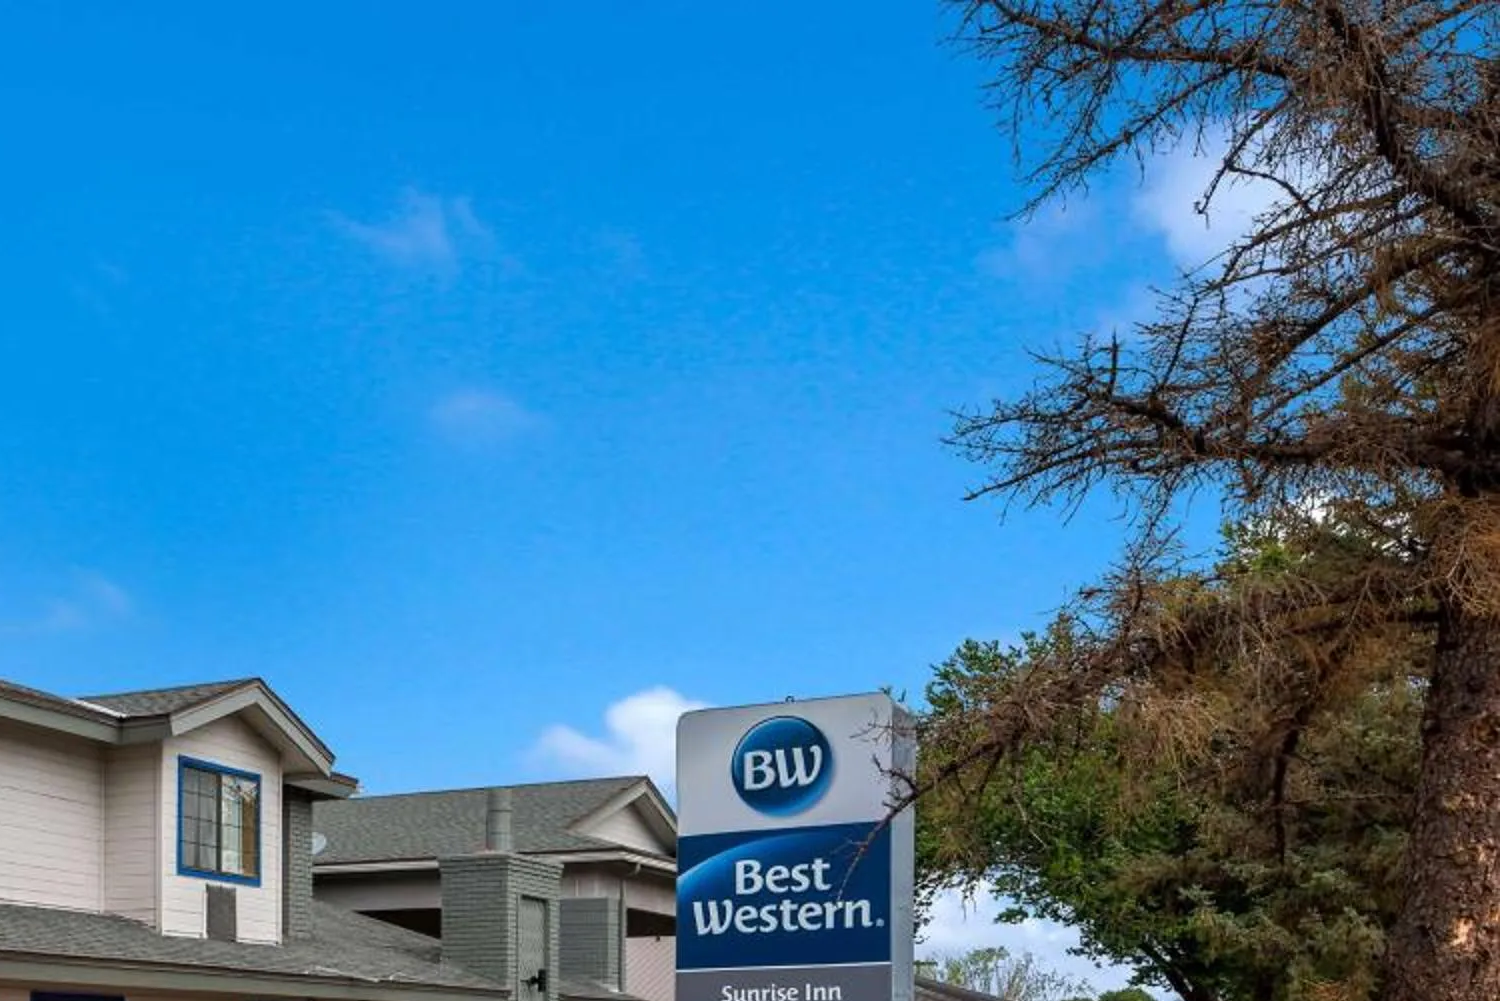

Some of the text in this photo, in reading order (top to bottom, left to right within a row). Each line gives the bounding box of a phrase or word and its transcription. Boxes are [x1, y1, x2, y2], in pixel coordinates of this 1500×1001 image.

[743, 745, 823, 791] BW
[735, 858, 832, 895] Best
[805, 983, 841, 1001] Inn
